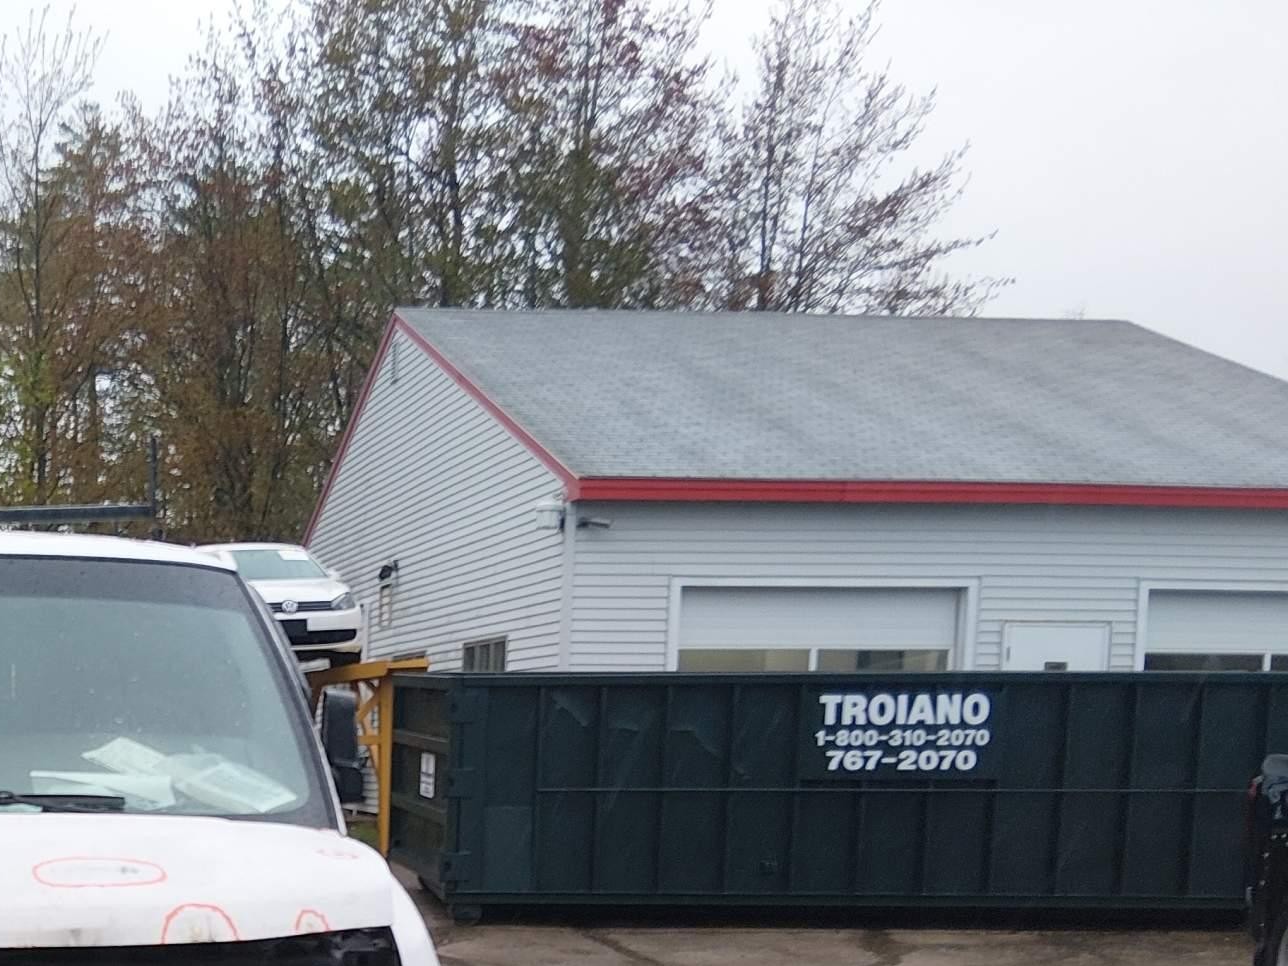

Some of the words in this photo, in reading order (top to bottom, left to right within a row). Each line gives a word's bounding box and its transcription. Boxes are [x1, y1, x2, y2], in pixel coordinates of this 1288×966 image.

[819, 693, 991, 726] TROIANO
[814, 729, 990, 747] 1-800-310-2070
[825, 750, 977, 771] 767-2070
